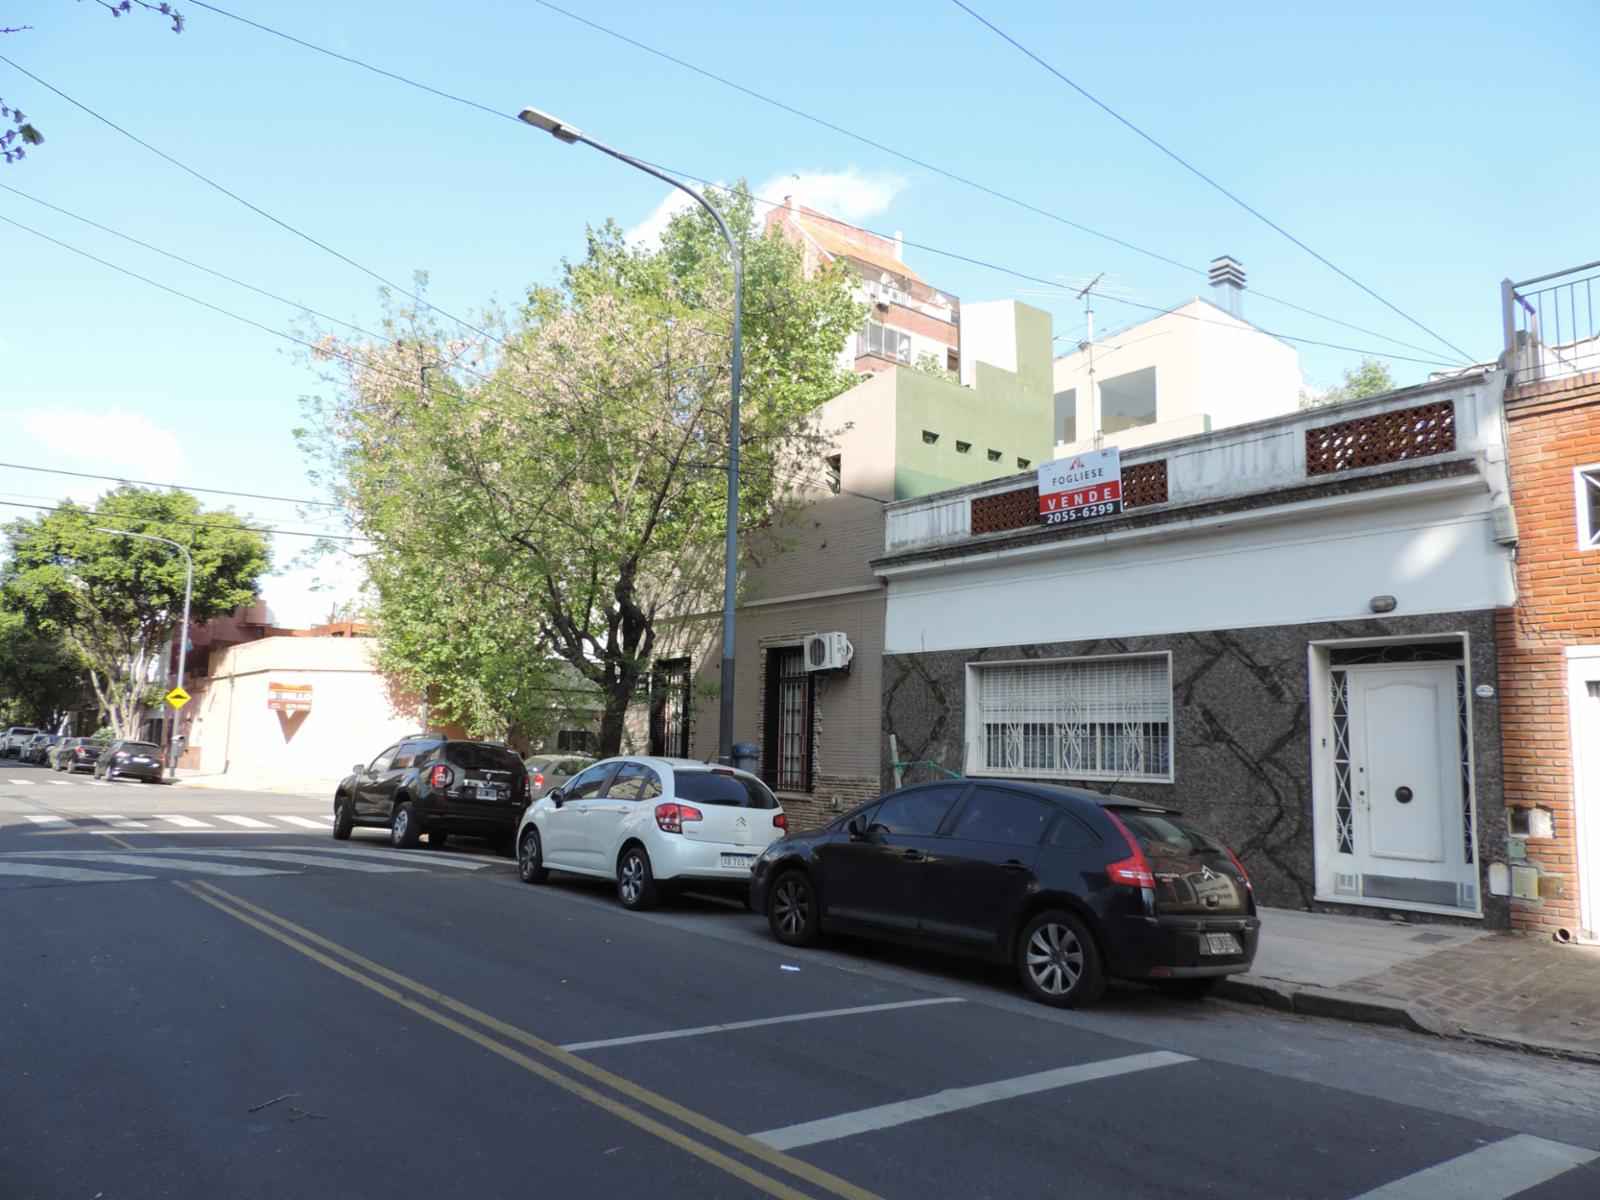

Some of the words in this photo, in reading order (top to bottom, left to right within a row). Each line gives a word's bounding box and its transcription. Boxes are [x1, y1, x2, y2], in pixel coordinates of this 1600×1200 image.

[1052, 468, 1104, 486] FOGLIESE
[1047, 488, 1112, 510] VENDE
[1047, 503, 1114, 524] 2055-6299
